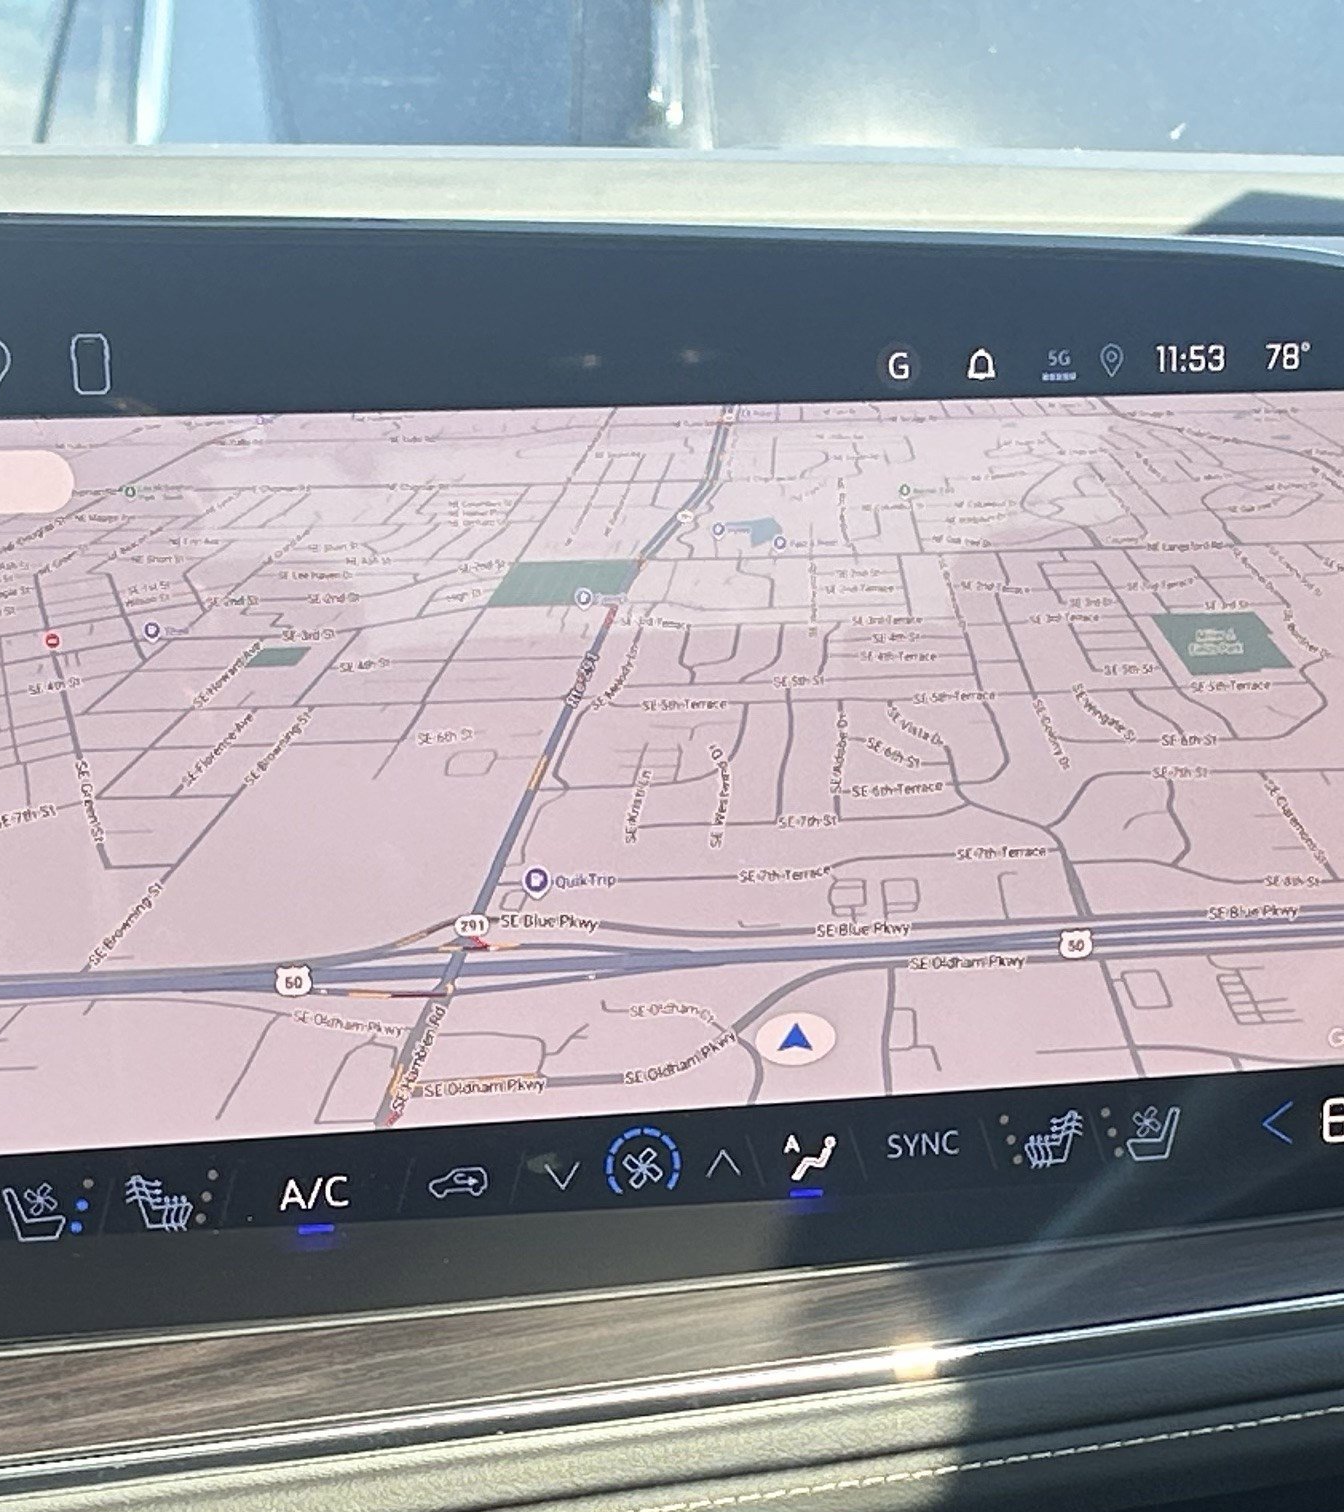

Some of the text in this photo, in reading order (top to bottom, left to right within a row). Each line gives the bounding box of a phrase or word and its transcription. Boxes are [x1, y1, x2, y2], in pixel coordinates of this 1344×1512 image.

[1048, 350, 1070, 366] 5G
[1156, 344, 1226, 373] 11:53
[1265, 341, 1311, 371] 78°
[888, 352, 910, 380] G
[301, 630, 320, 640] 3rd
[207, 662, 247, 698] Howard
[1231, 680, 1270, 690] Terrace
[957, 690, 995, 701] Terrace
[685, 701, 727, 709] Terrace
[1084, 701, 1126, 732] Wingate
[902, 719, 929, 742] Vista
[196, 731, 236, 774] Florence
[233, 713, 254, 734] Ave
[258, 726, 303, 773] Browning
[297, 710, 312, 726] St
[867, 737, 882, 751] SE
[1205, 735, 1216, 745] St
[76, 760, 90, 780] SE
[852, 780, 943, 797] SE 6th Terrace
[15, 810, 38, 824] 7th
[40, 806, 56, 817] St
[779, 815, 837, 828] SE 7th St
[957, 845, 1046, 860] SE 7th Terrace
[739, 866, 830, 882] SE 7th Terrace
[1209, 905, 1298, 919] SE Blue Pkwy
[89, 883, 163, 965] SE Browning St
[461, 920, 485, 931] 291
[501, 916, 598, 931] SE Blue Pkwy
[817, 921, 910, 937] SE Blue Pkwy
[1068, 940, 1084, 950] 50
[910, 956, 1025, 969] SE Oldham Pkwy
[630, 1006, 648, 1017] SE
[650, 1003, 699, 1016] Oldham
[294, 1012, 404, 1036] SE Oldham Pkwy
[392, 1006, 445, 1111] SE Hamblen Rd
[625, 1030, 736, 1084] SE Oldham Pkwy
[424, 1078, 545, 1098] SE Oldham Pkwy
[887, 1131, 959, 1158] SYNC
[280, 1176, 350, 1210] A/C
